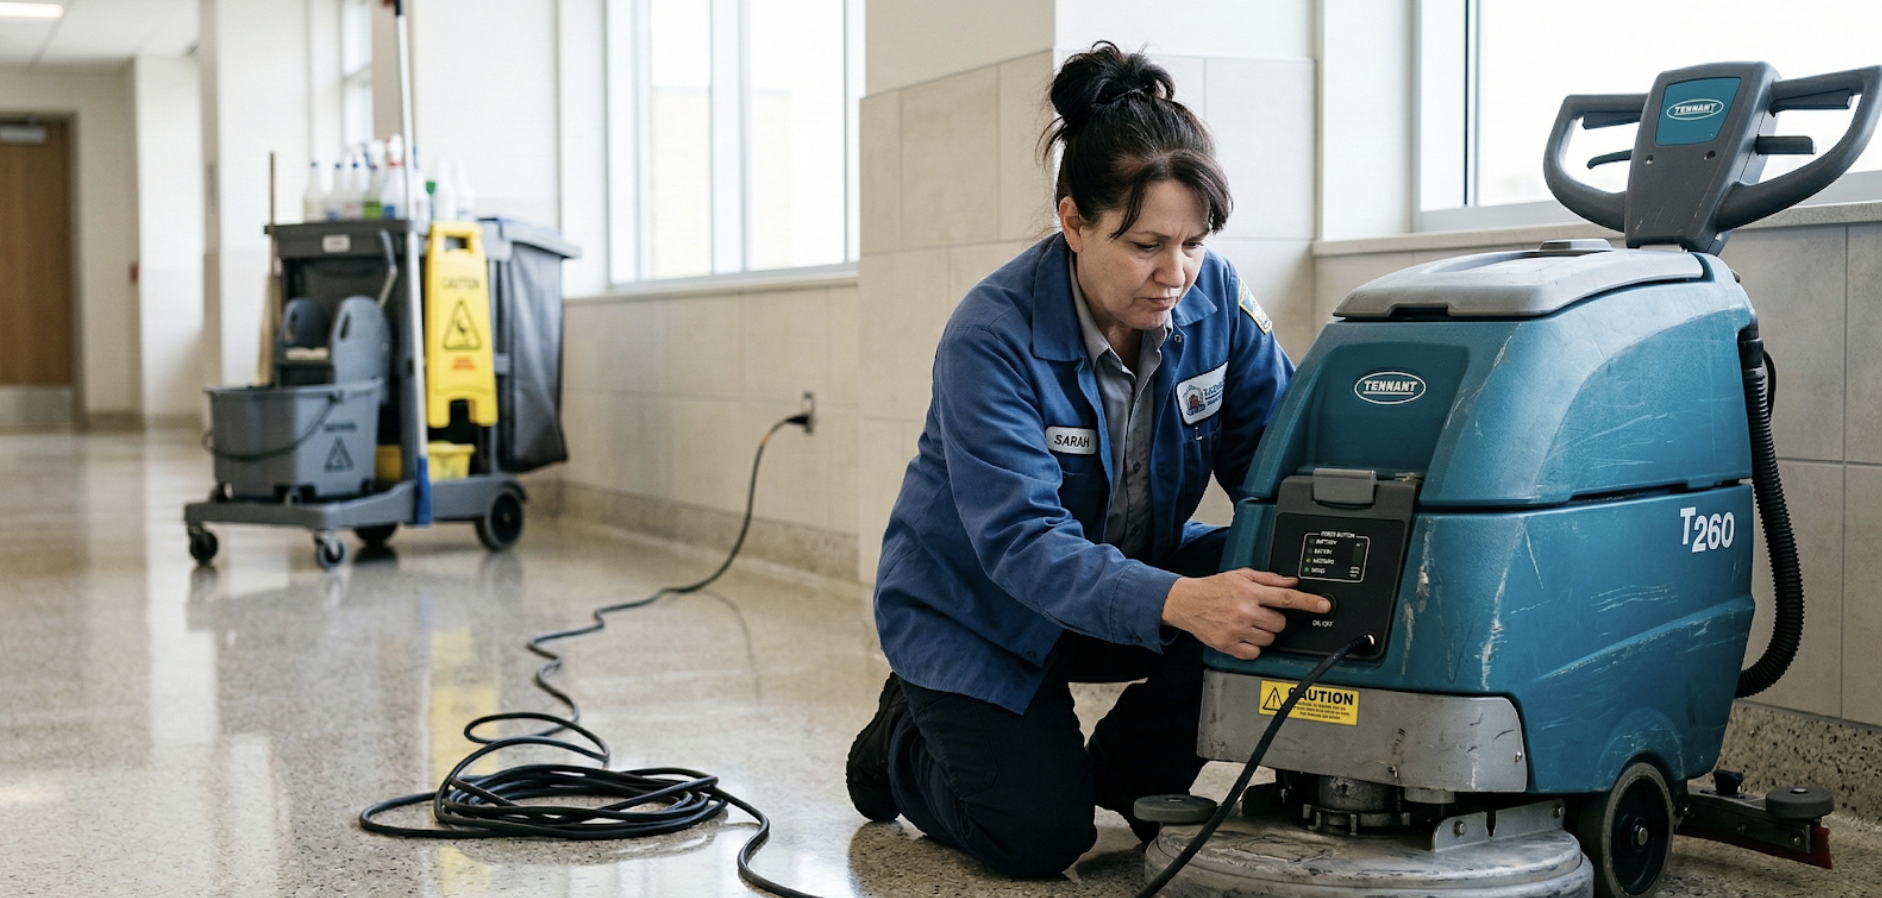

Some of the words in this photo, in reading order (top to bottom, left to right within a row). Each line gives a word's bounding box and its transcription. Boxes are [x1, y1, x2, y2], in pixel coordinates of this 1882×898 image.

[1674, 103, 1717, 115] TENNANT
[1364, 380, 1418, 393] TENNANT
[1053, 434, 1090, 448] SARAH
[1679, 506, 1735, 553] T260
